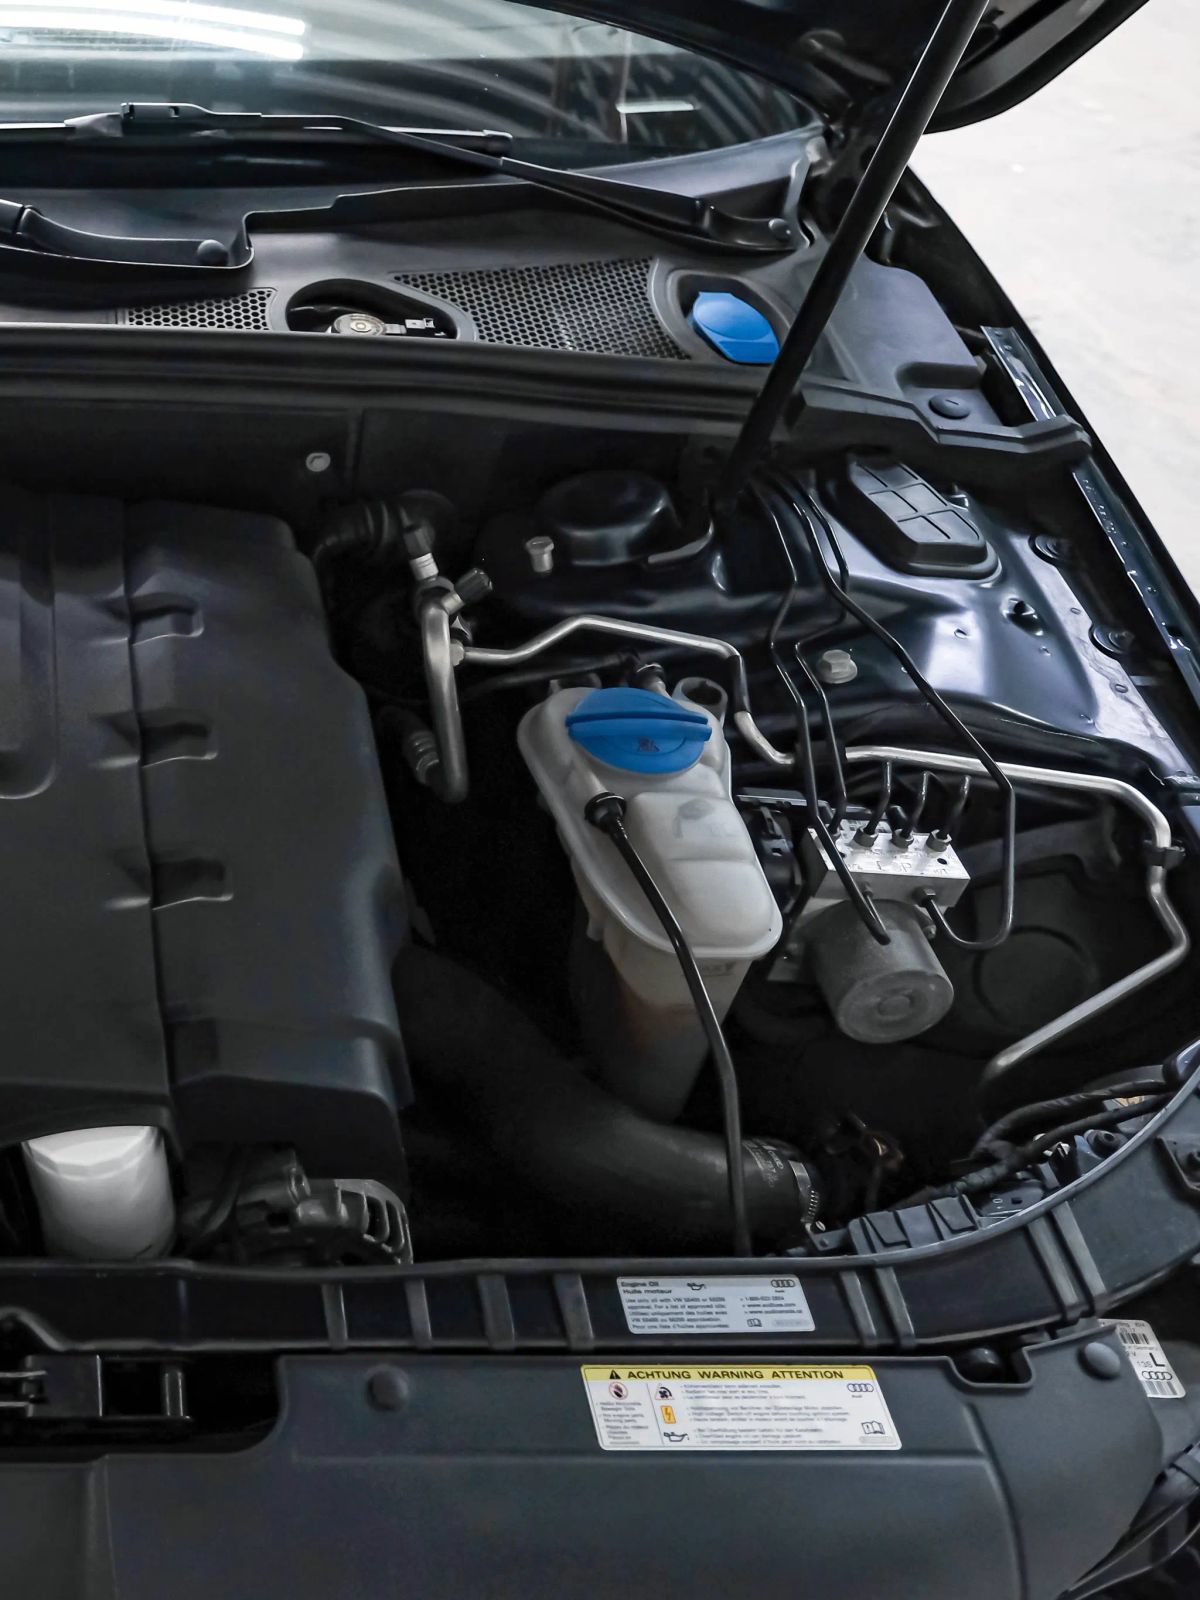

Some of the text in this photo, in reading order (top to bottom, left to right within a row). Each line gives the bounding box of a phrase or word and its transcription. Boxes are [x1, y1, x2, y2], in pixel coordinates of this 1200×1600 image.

[1149, 1352, 1166, 1367] L
[627, 1370, 844, 1379] ACHTUNG WARNING ATTENTION
